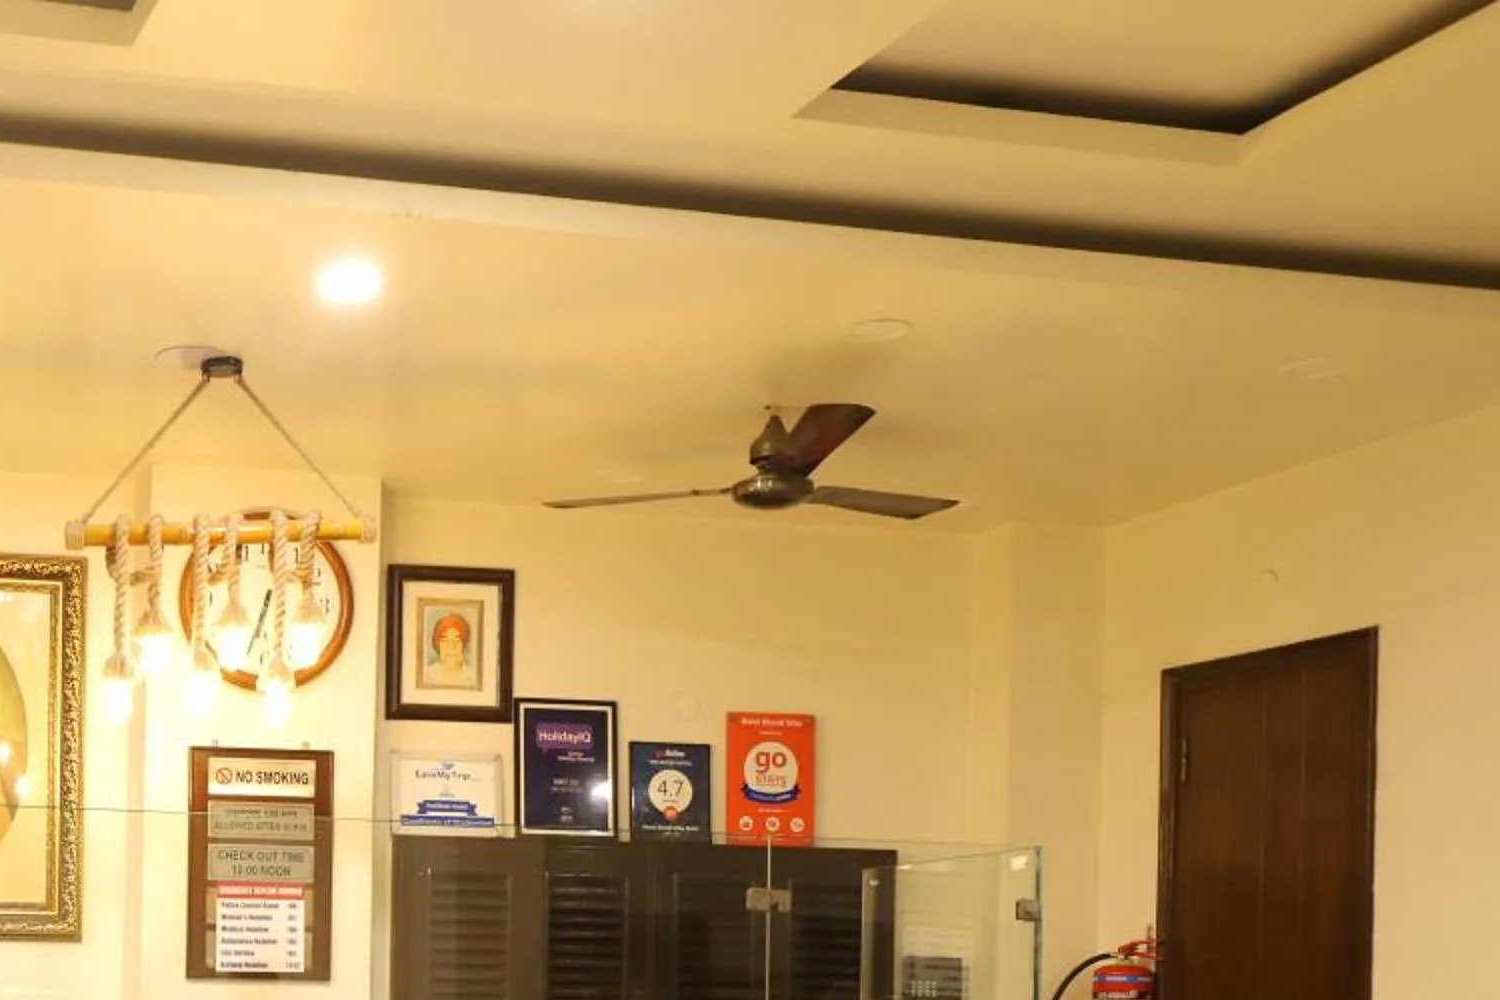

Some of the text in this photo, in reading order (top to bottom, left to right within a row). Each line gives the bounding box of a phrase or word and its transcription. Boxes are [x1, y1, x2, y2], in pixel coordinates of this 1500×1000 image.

[539, 730, 591, 745] HolidayIQ
[755, 751, 787, 774] go
[235, 769, 309, 785] NO SMOKING
[657, 779, 685, 797] 4.7
[218, 850, 254, 862] CHECK
[256, 851, 278, 863] OUT
[260, 865, 291, 877] NOON
